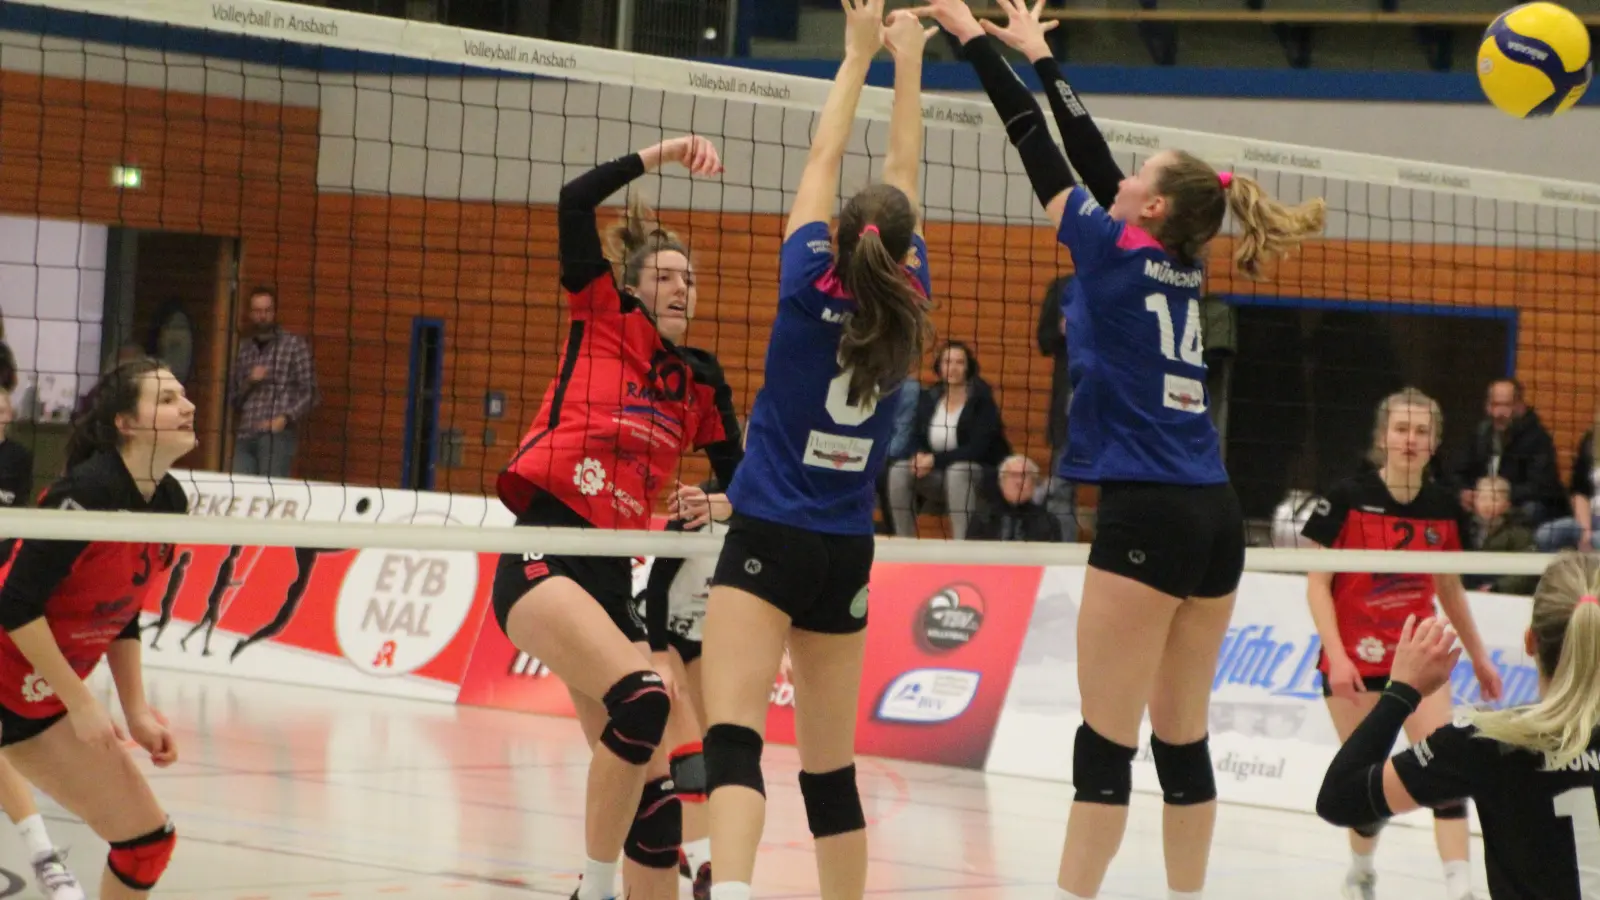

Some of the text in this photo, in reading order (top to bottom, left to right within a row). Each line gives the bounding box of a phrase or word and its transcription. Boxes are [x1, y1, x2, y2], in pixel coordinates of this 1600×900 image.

[212, 4, 338, 37] Volleyball in Ansbach
[464, 39, 577, 69] Volleyball in Ansbach
[688, 72, 791, 99] Volleyball in Ansbach
[946, 108, 984, 126] Ansbach
[1145, 293, 1207, 368] 14
[375, 554, 449, 597] EYB
[360, 597, 432, 637] NAL
[1217, 752, 1286, 781] digital
